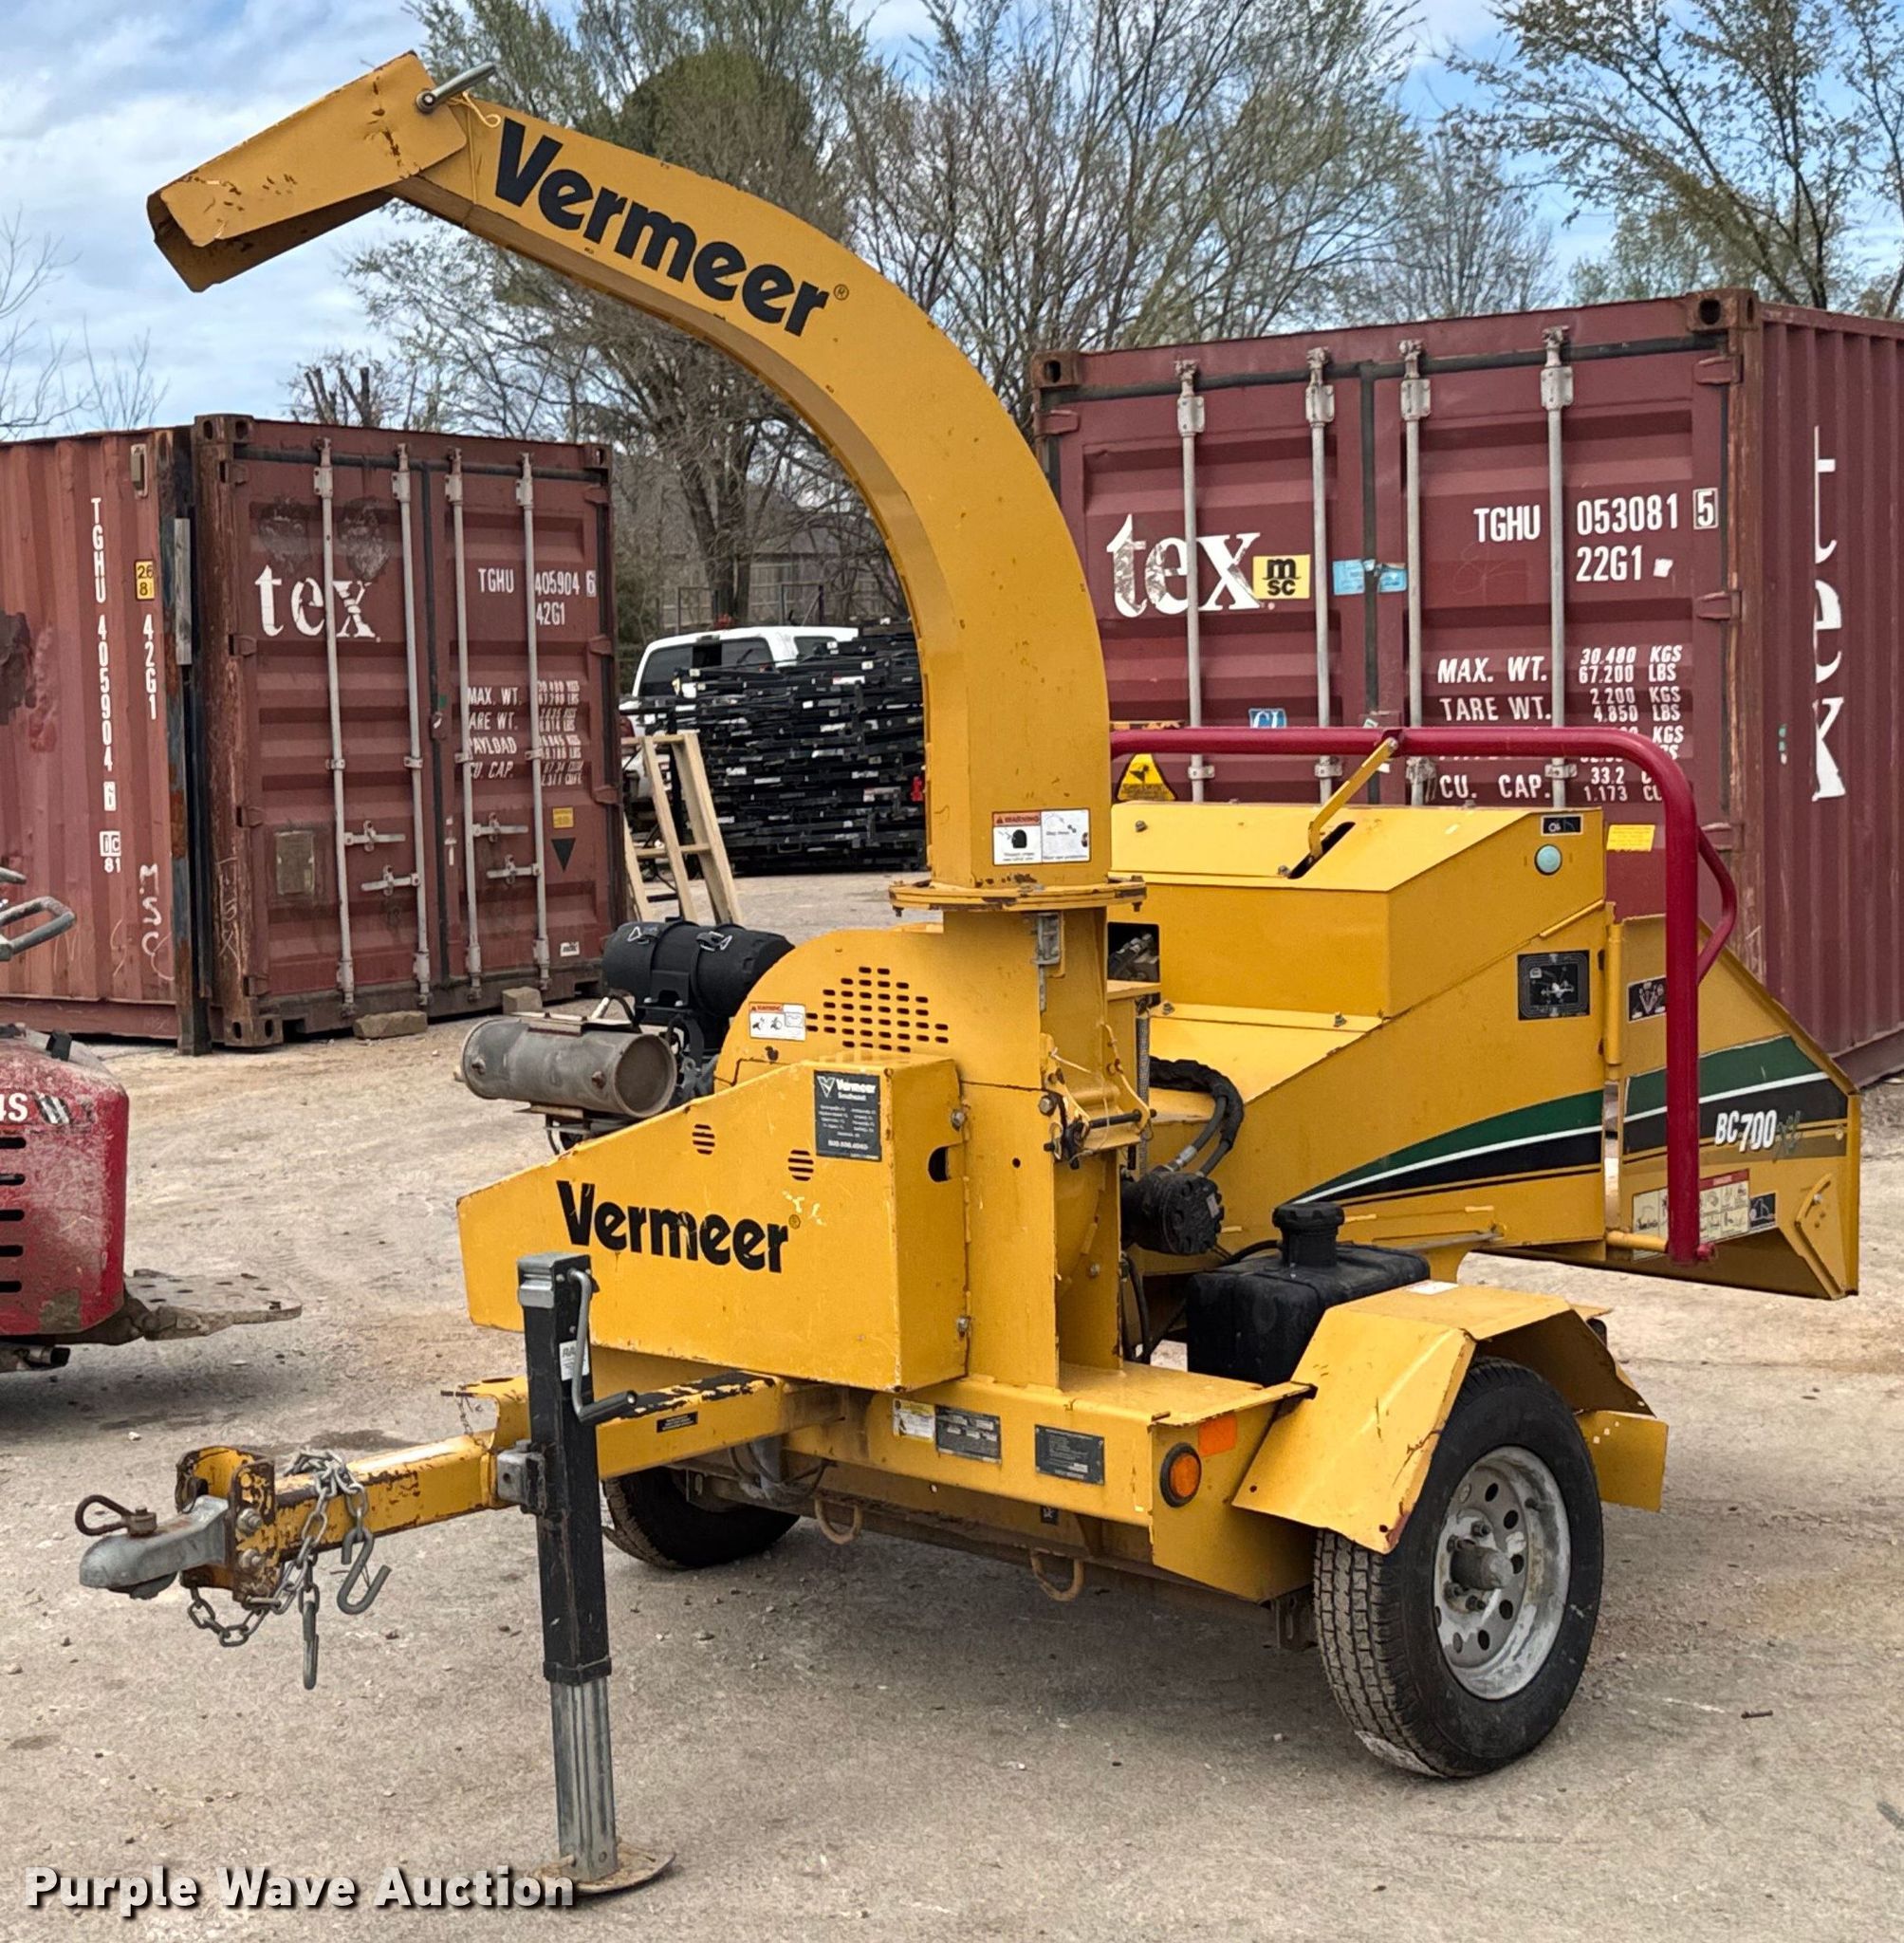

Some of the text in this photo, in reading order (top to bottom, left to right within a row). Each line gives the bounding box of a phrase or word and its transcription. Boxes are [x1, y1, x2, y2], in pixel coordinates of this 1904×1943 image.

[495, 117, 828, 336] Vermeer
[1473, 490, 1714, 543] TGHU 053081 5
[90, 497, 106, 603] TGHU
[1576, 546, 1643, 582] 22G1
[478, 567, 514, 593] TGHU
[534, 570, 581, 596] 405904
[536, 601, 565, 625] 42G1
[143, 614, 157, 720] 42G1
[1581, 645, 1682, 665] 30.480 KGS
[1437, 656, 1547, 683] MAX. WT.
[1579, 663, 1676, 684] 67.200 LBS
[98, 615, 113, 771] 405904
[1590, 686, 1681, 705] 2.200 KGS
[1439, 695, 1552, 721] TARE WT.
[1594, 704, 1681, 722] 4.850 LBS
[469, 712, 490, 731] ARE
[1652, 726, 1684, 743] KGS
[1439, 774, 1551, 799] CU. CAP.
[1591, 767, 1624, 785] 33.2
[1583, 786, 1628, 803] 1.173
[104, 858, 120, 873] 81
[556, 1180, 789, 1273] Vermeer
